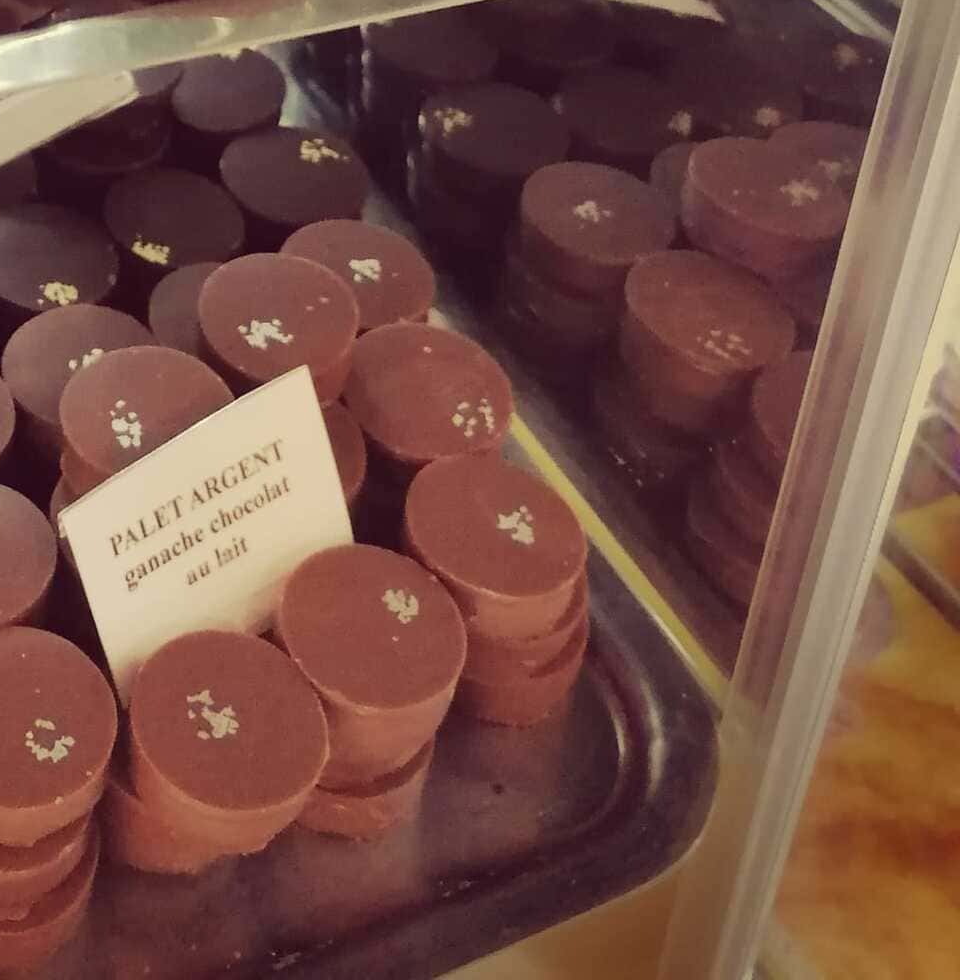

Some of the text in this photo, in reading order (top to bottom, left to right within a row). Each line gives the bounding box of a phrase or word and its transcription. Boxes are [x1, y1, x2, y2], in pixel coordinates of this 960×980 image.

[109, 439, 283, 556] PALET ARGENT
[124, 477, 291, 592] ganache chocolat
[187, 537, 249, 586] au lait
